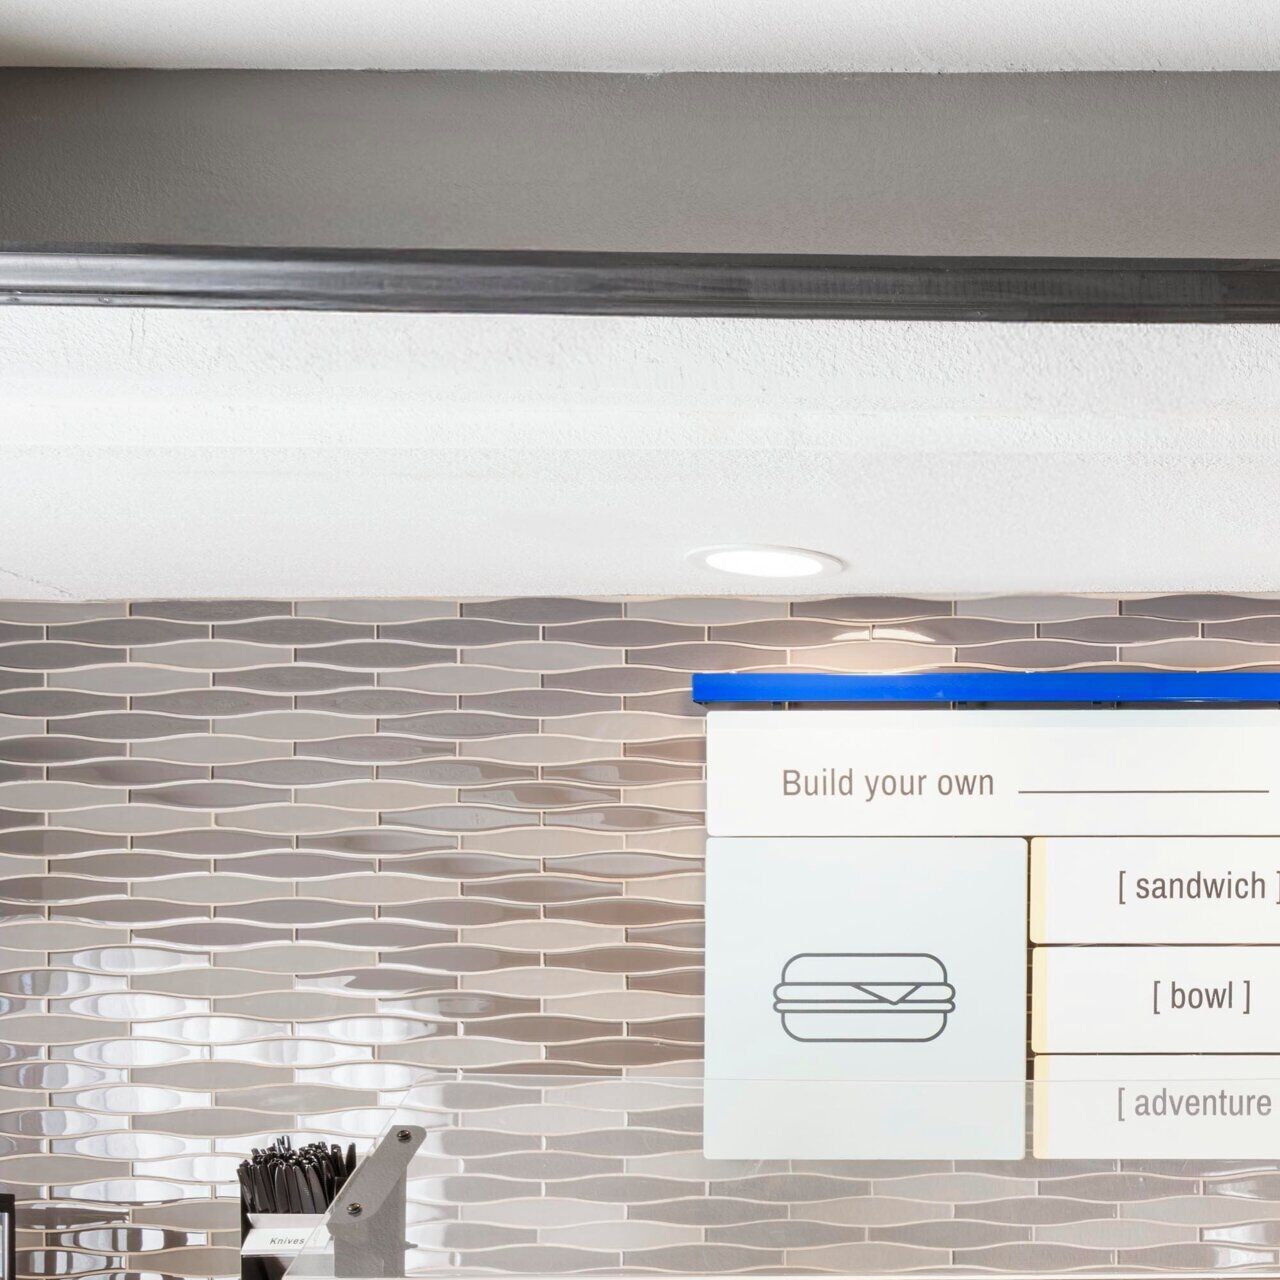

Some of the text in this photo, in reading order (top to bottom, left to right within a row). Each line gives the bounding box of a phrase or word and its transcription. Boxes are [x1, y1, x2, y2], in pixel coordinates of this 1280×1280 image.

[783, 767, 994, 803] Build your own
[269, 1236, 305, 1245] Knives
